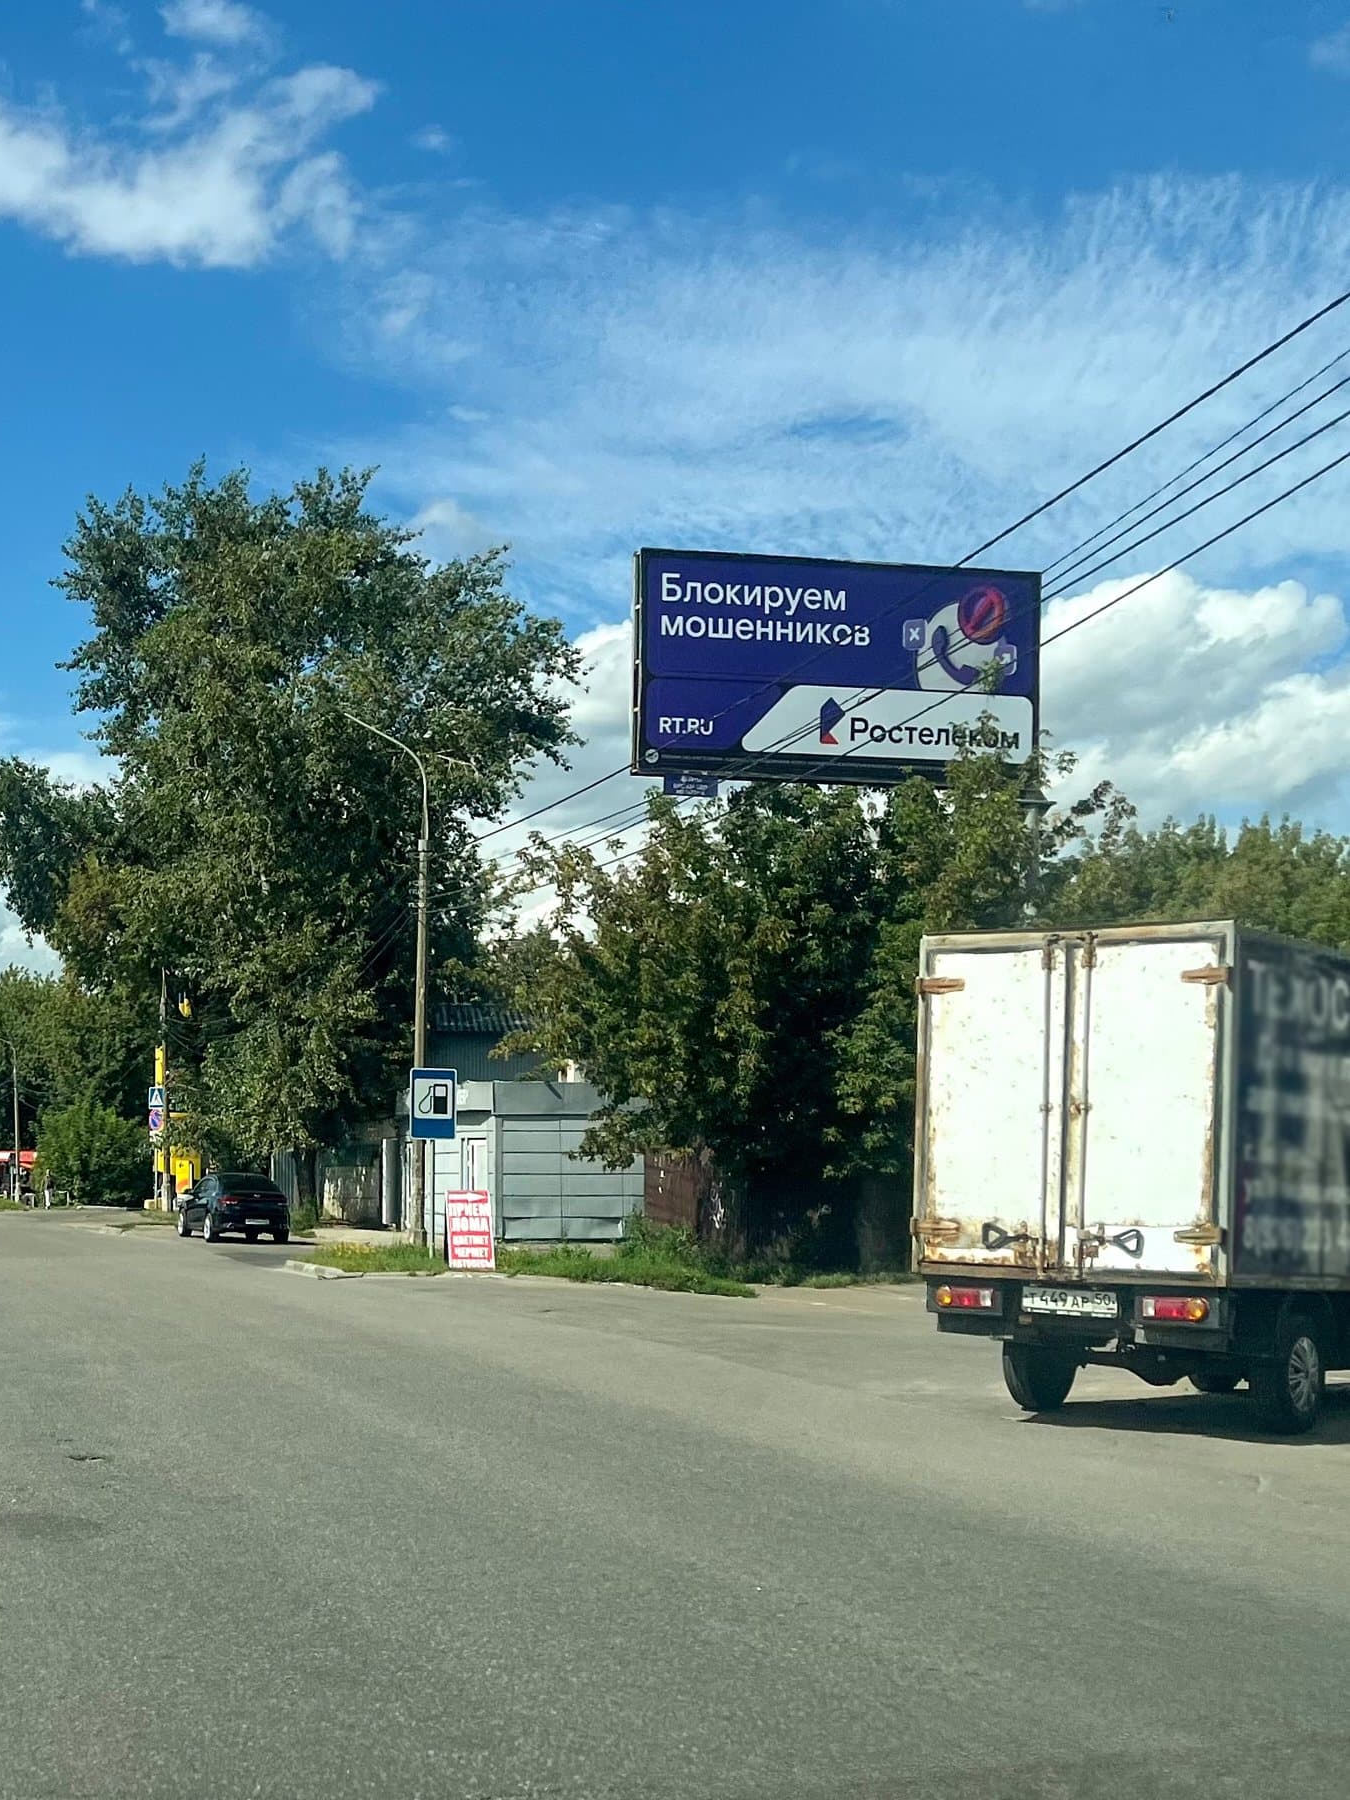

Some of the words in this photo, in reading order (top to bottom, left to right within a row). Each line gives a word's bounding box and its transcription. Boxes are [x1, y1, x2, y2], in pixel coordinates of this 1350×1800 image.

[661, 572, 847, 616] Блокируем
[660, 614, 871, 647] мошенников
[658, 717, 714, 736] RT.RU
[849, 716, 1020, 750] Ростелеком
